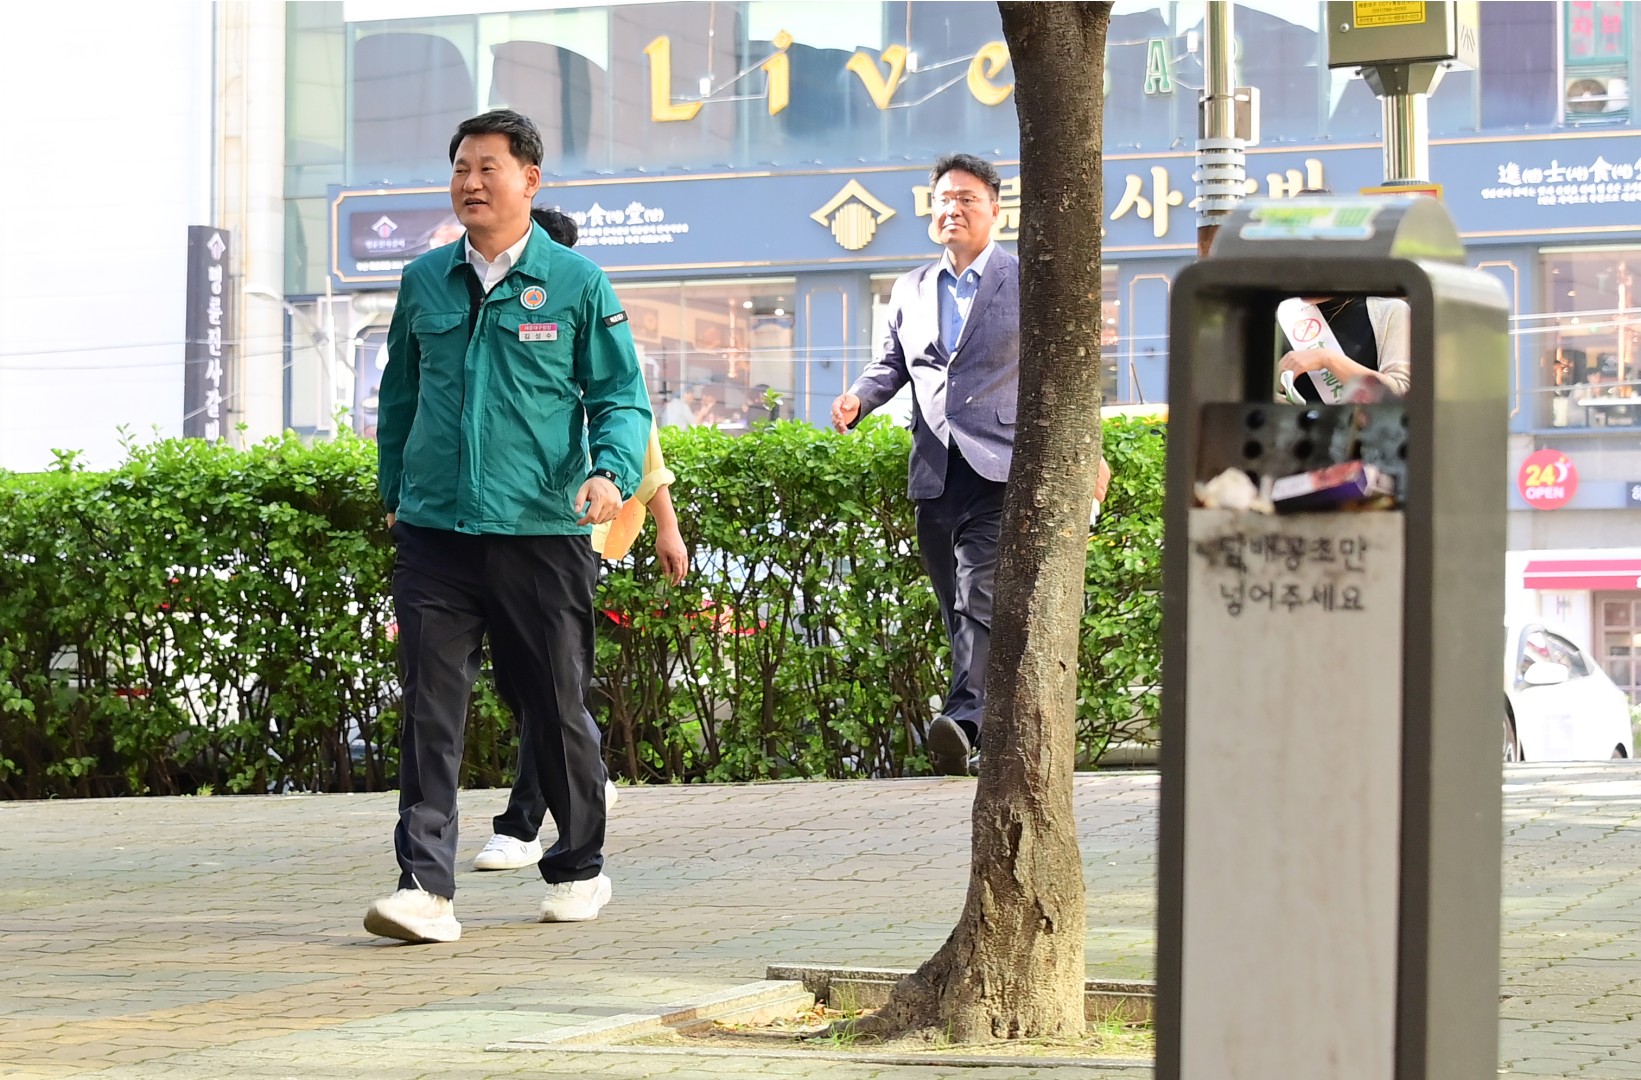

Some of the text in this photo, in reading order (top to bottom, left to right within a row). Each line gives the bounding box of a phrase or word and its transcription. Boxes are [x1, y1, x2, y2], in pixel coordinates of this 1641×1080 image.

[643, 28, 1014, 122] Live
[205, 264, 223, 441] 명륜진사갈비
[1525, 463, 1555, 487] 24
[1525, 486, 1564, 500] OPEN
